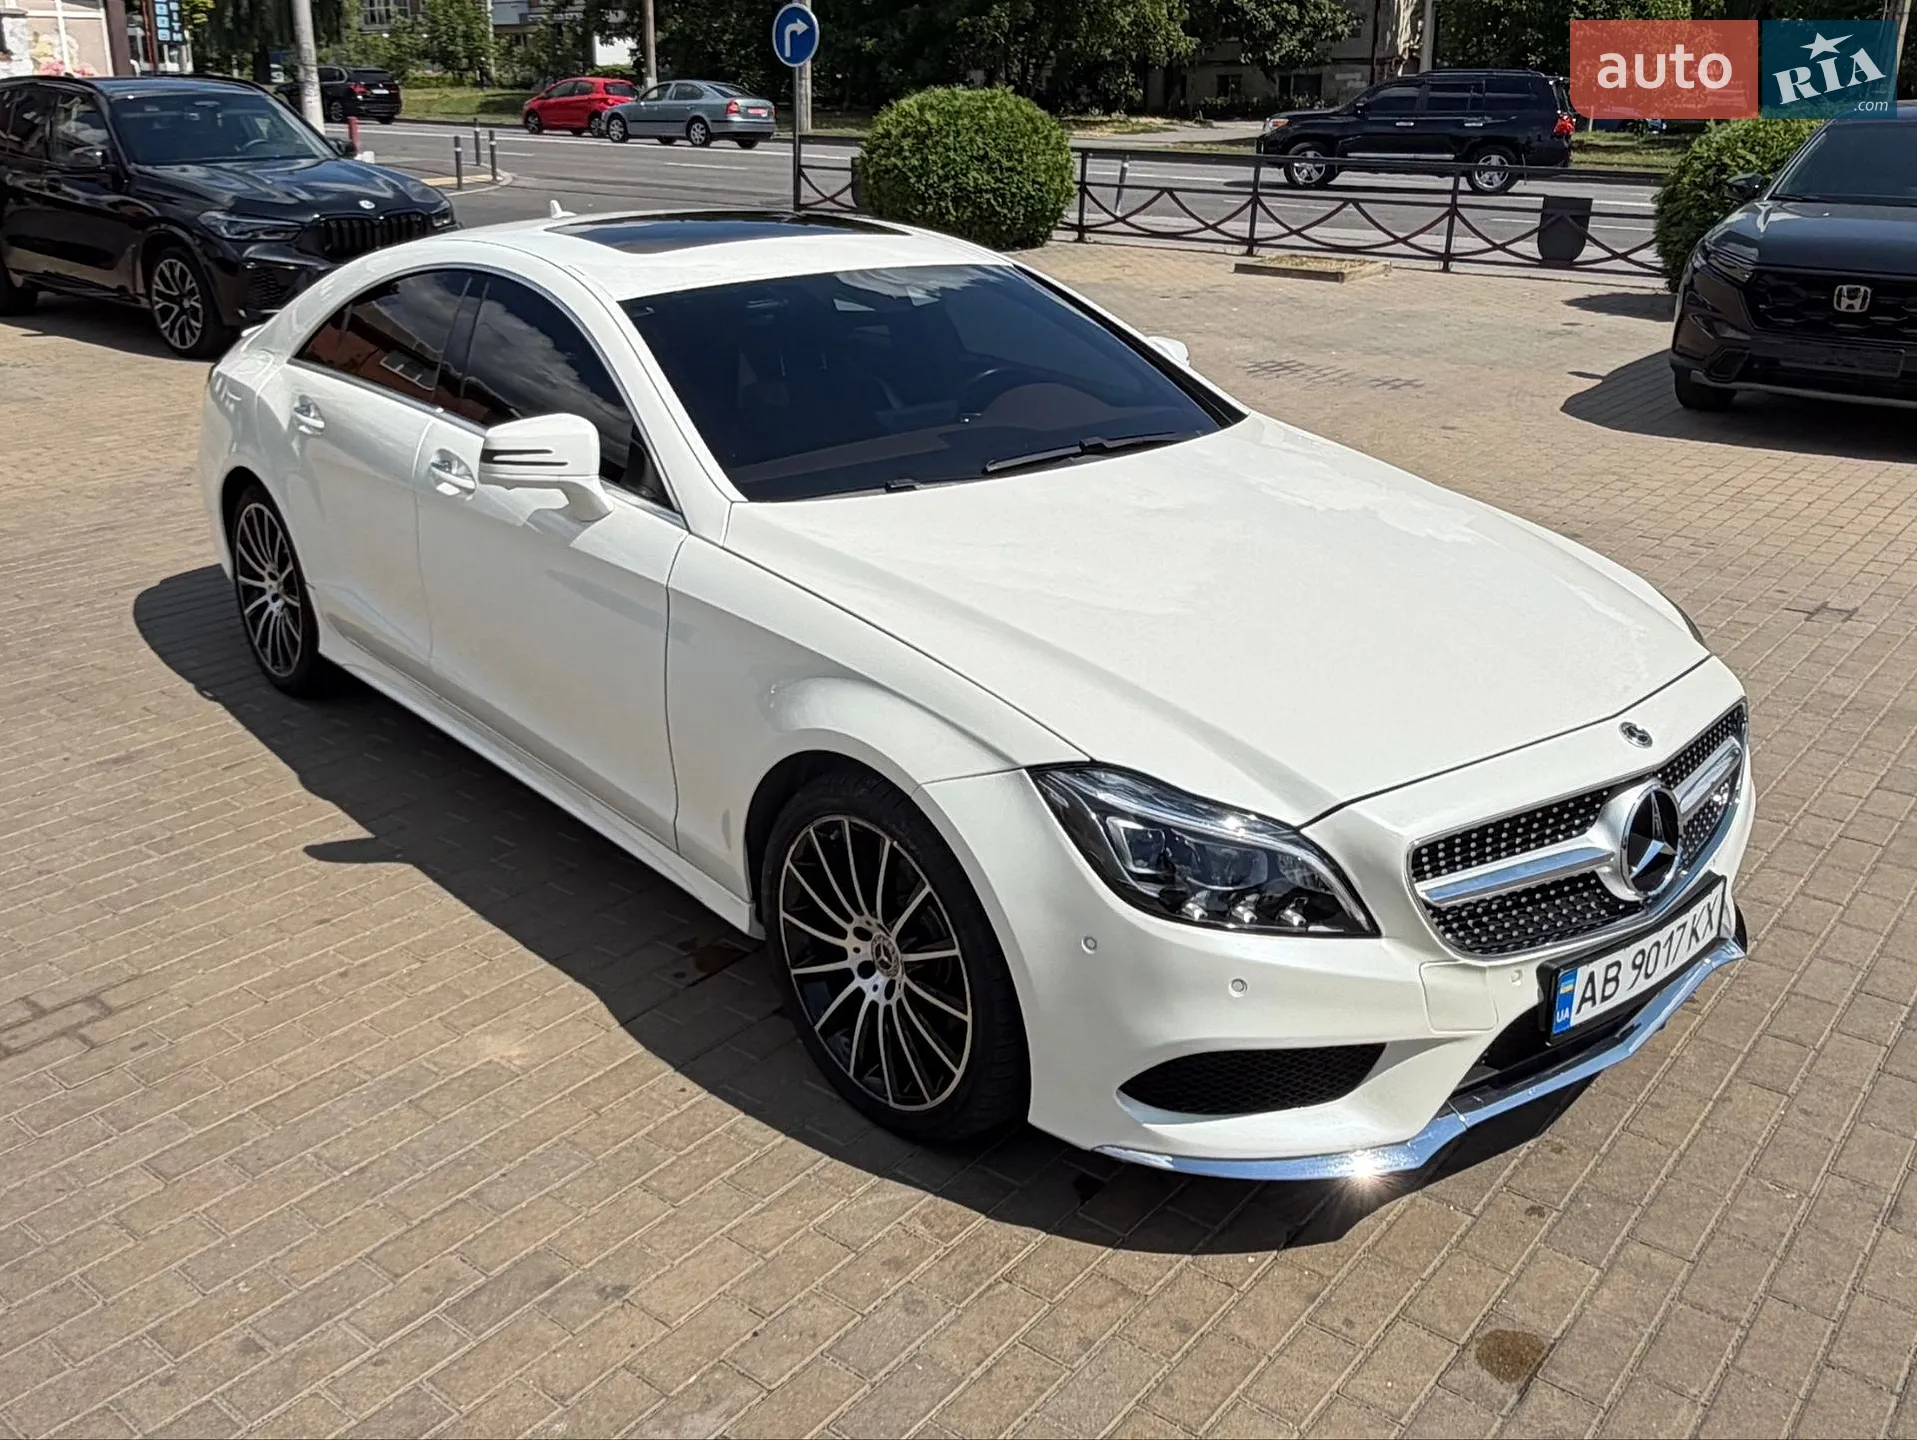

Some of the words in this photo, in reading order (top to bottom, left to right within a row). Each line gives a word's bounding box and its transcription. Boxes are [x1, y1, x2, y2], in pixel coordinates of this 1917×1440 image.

[1575, 960, 1622, 1016] AB
[1626, 920, 1688, 991] 9017
[1686, 894, 1719, 952] KX
[1555, 1008, 1570, 1024] UA
